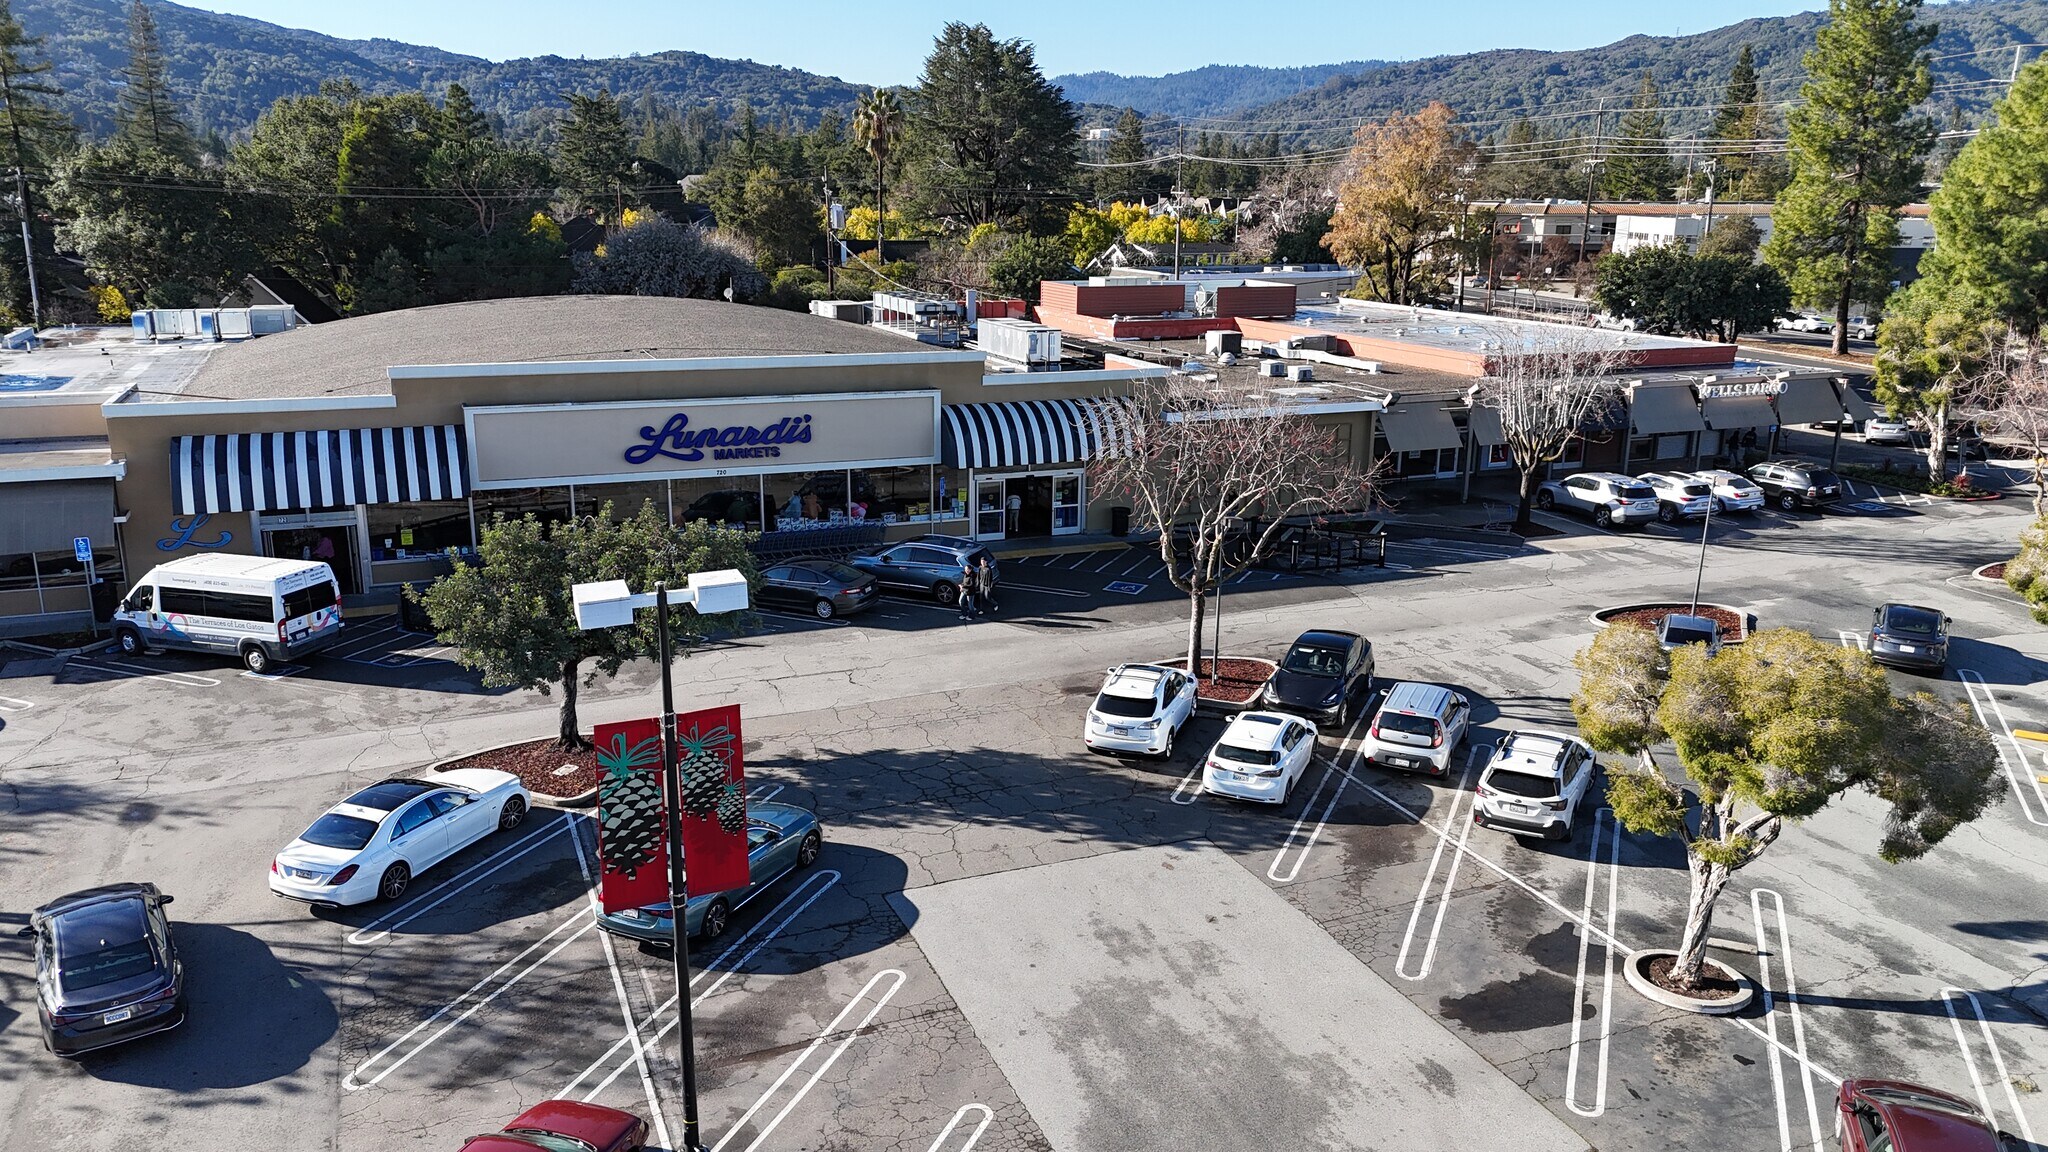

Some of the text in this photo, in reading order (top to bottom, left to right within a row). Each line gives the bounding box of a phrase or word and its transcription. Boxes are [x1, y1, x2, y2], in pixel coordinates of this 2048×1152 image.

[1698, 381, 1788, 399] WELLS FARGO
[624, 413, 812, 464] Lunardi's
[714, 446, 780, 460] MARKETS
[156, 513, 233, 551] L
[188, 617, 200, 625] The
[201, 618, 226, 627] Terraces
[234, 621, 245, 629] Los
[246, 623, 265, 631] Gatos
